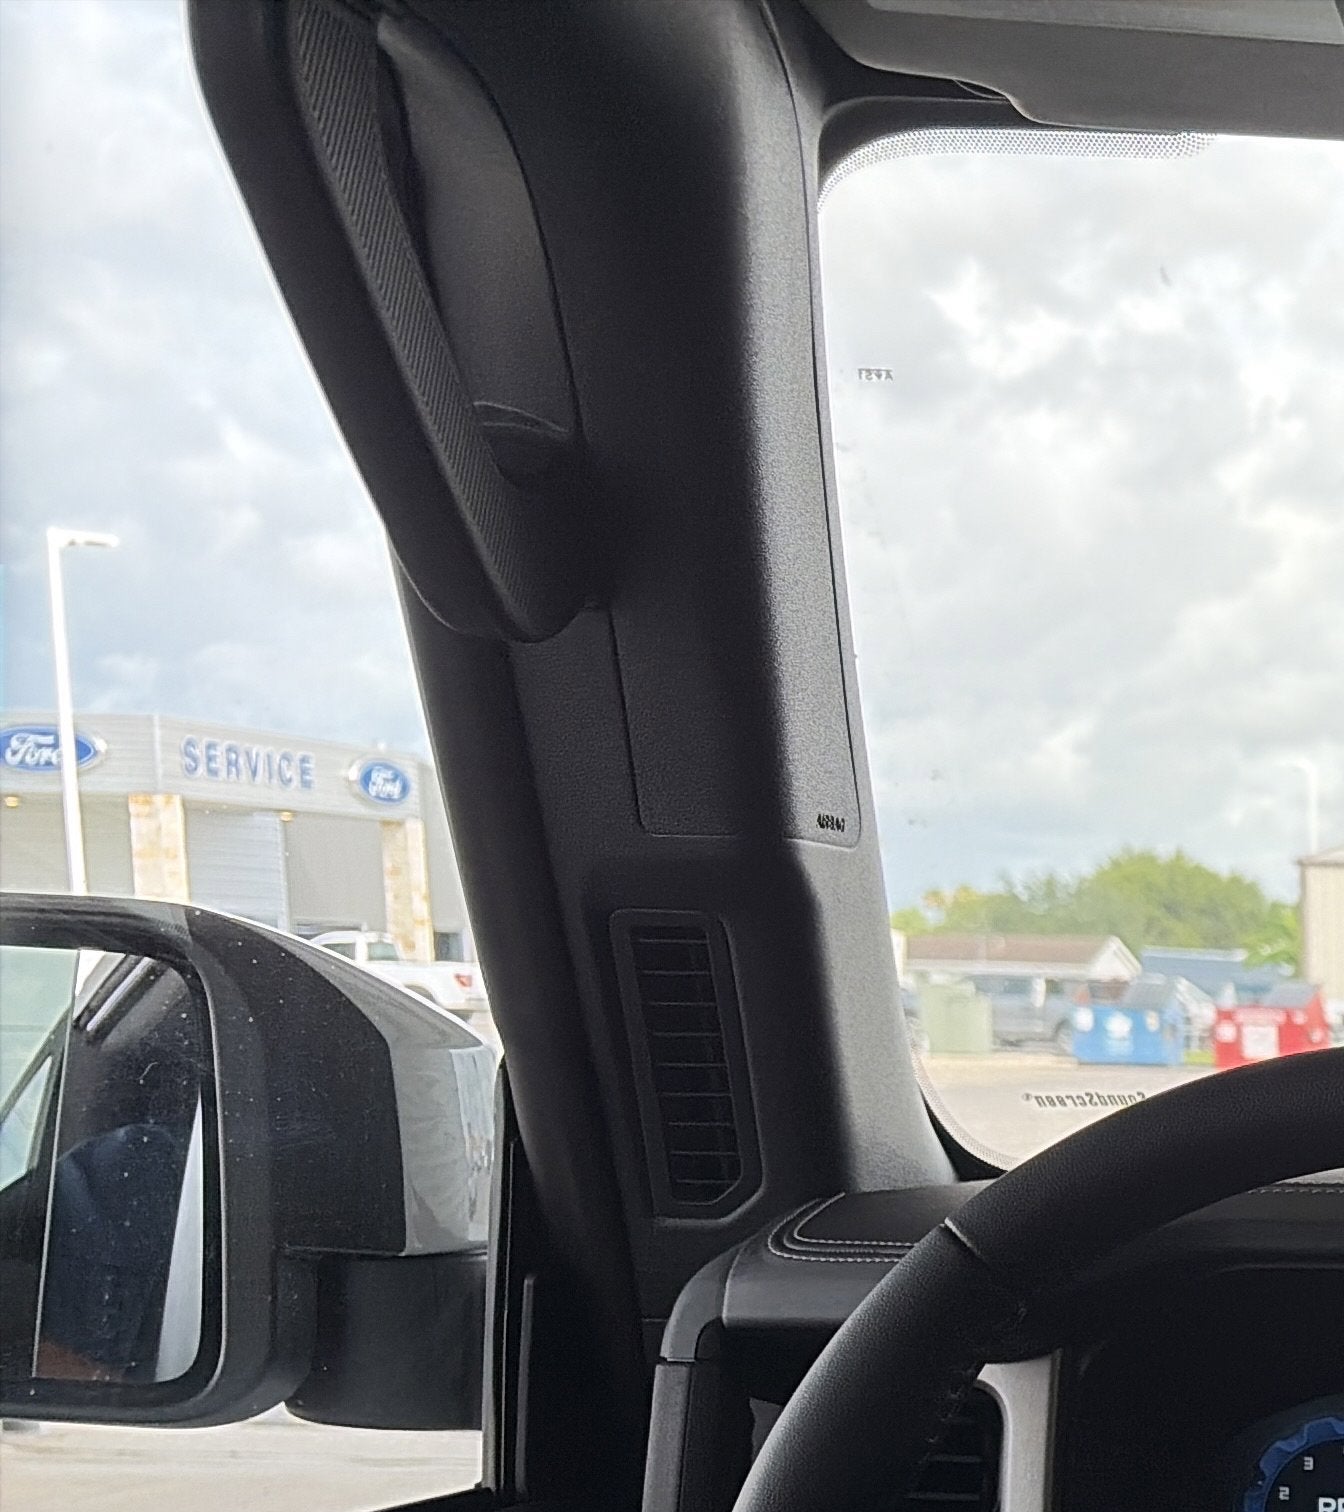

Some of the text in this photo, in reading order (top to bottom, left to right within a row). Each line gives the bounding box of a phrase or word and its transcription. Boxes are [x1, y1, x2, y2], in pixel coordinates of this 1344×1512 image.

[182, 735, 315, 790] SERVICE
[1303, 1456, 1314, 1471] 3
[1278, 1486, 1290, 1501] 2
